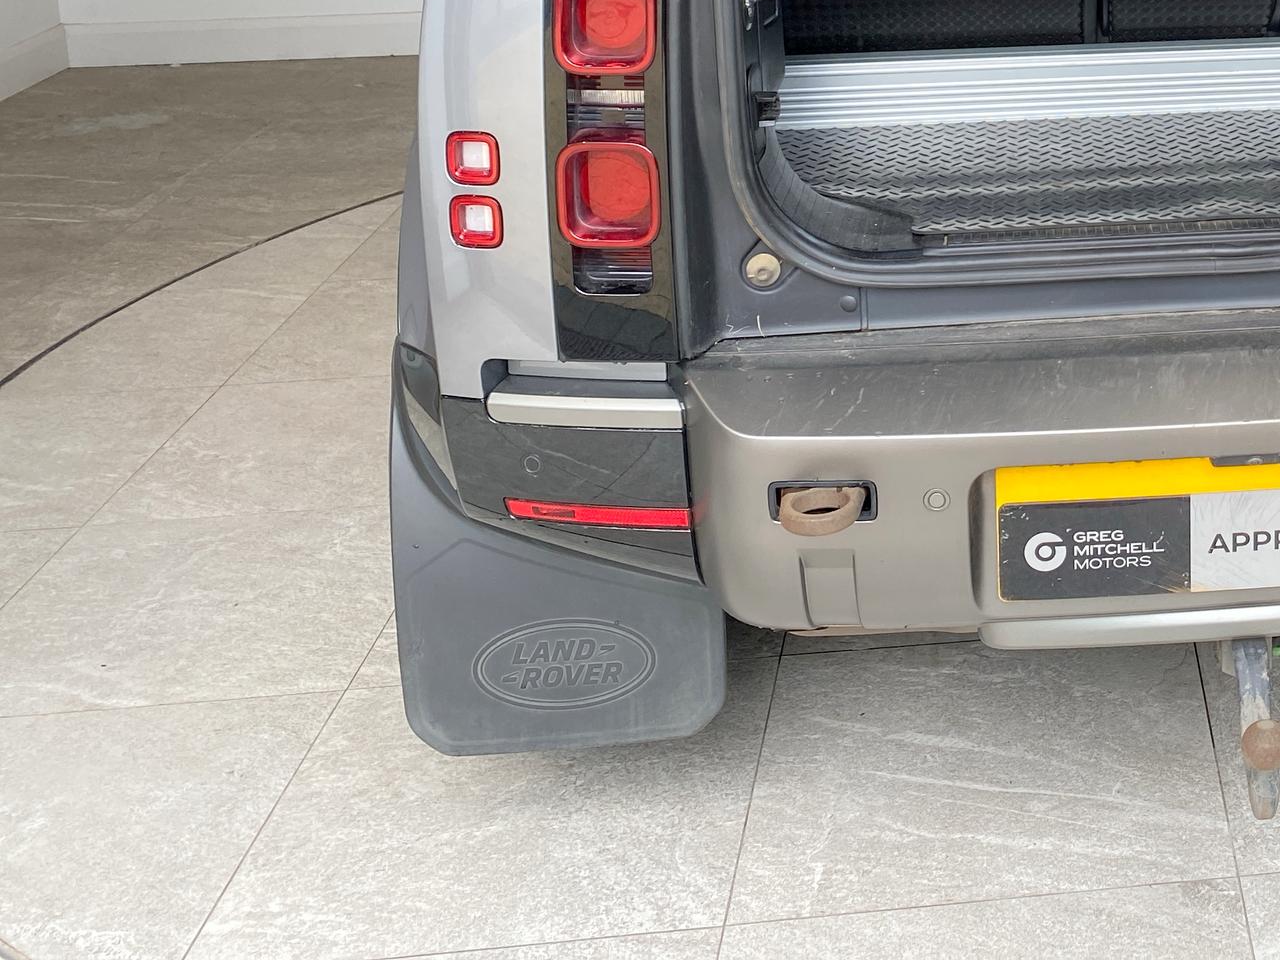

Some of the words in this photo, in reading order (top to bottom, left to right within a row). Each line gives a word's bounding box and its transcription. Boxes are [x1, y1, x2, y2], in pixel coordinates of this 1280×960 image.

[1072, 529, 1125, 543] GREG
[1073, 540, 1166, 557] MITCHELL
[1073, 555, 1152, 570] MOTORS
[511, 638, 597, 665] LAND
[519, 661, 624, 689] ROVER
